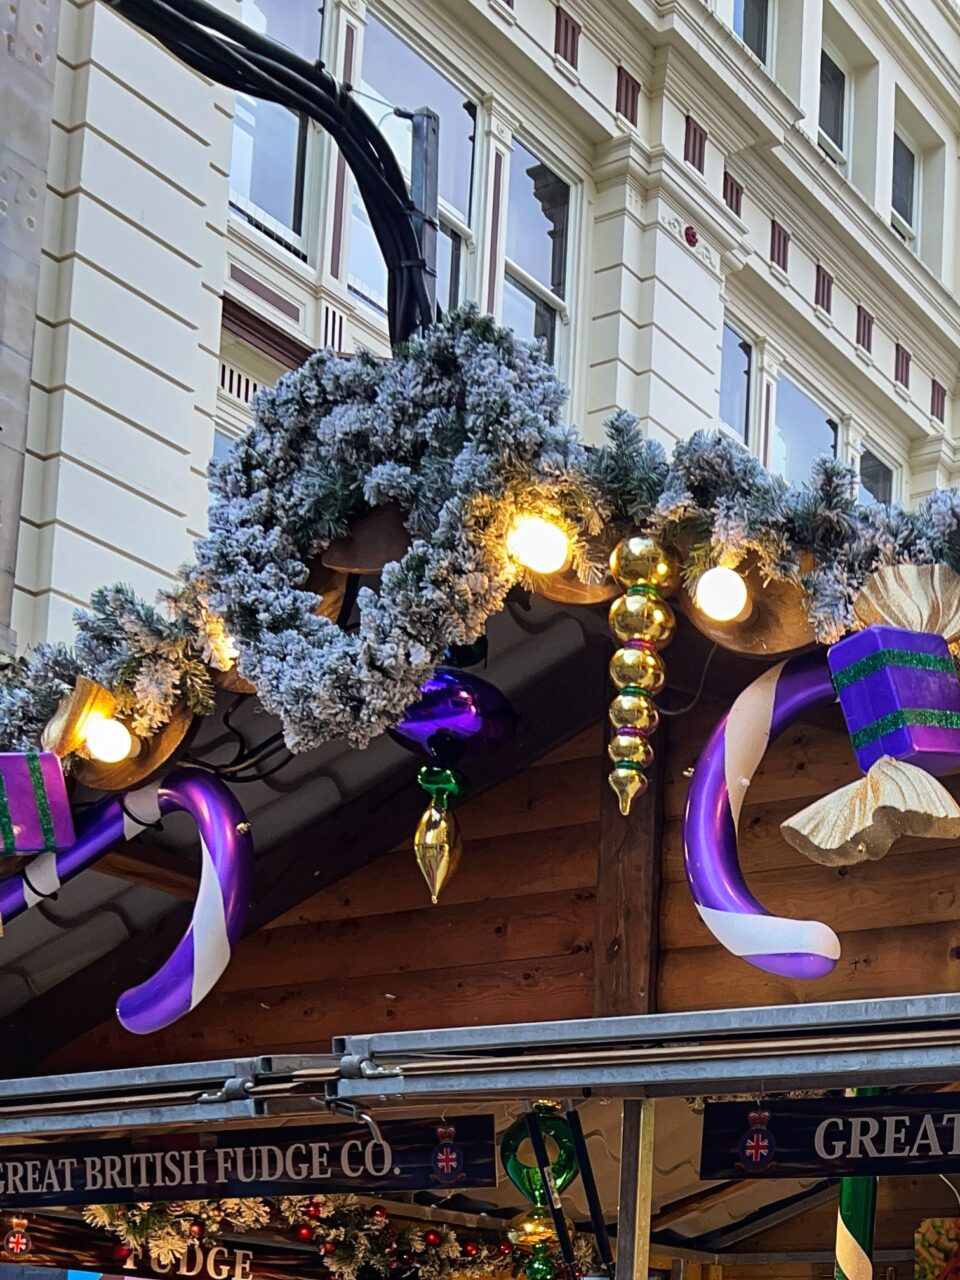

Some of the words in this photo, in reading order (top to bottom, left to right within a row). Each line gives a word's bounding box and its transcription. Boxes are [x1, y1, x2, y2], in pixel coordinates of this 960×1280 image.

[0, 1158, 77, 1194] REAT
[84, 1150, 207, 1190] BRITISH
[215, 1142, 331, 1183] FUDGE
[341, 1140, 400, 1177] CO.
